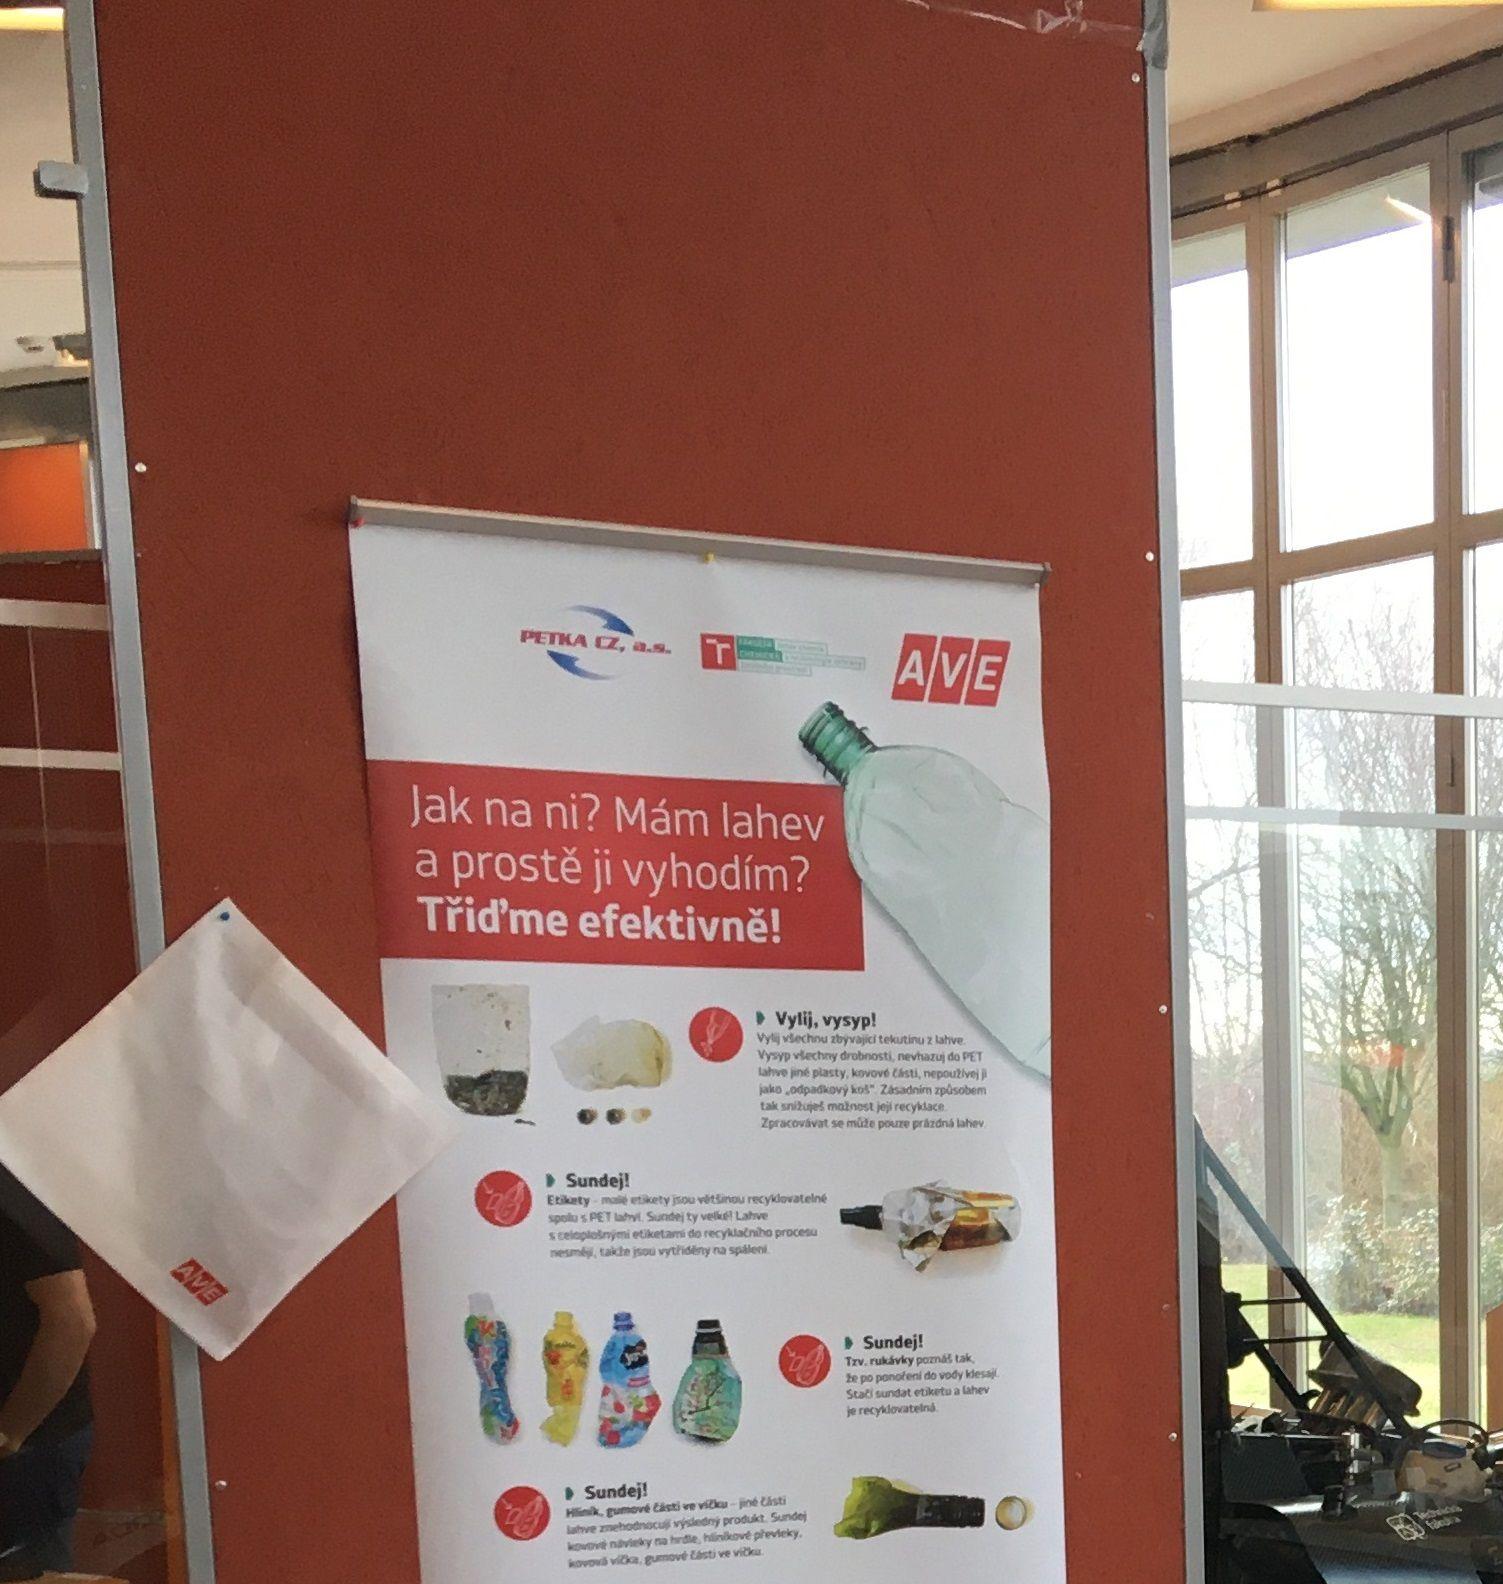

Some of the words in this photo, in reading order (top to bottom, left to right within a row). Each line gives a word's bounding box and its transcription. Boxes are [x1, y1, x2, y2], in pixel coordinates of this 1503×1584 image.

[520, 629, 588, 648] PETKA
[594, 635, 626, 653] CZ,
[632, 641, 671, 654] a.s.
[897, 648, 1004, 692] AVE
[410, 784, 473, 828] Jak
[485, 797, 532, 828] na
[546, 793, 600, 832] ni?
[616, 796, 709, 837] Mám
[723, 801, 825, 842] lahev
[416, 849, 438, 878] a
[452, 847, 581, 888] prostě
[593, 849, 612, 894] ji
[623, 852, 810, 898] vyhodím?
[417, 895, 568, 936] Třiďme
[579, 902, 782, 944] efektivně!
[775, 1011, 818, 1029] Vylij,
[822, 1013, 876, 1030] vysyp!
[565, 1173, 629, 1190] Sundej!
[174, 1262, 223, 1302] AVE
[863, 1334, 923, 1350] Sundej!
[584, 1482, 647, 1499] Sundej!
